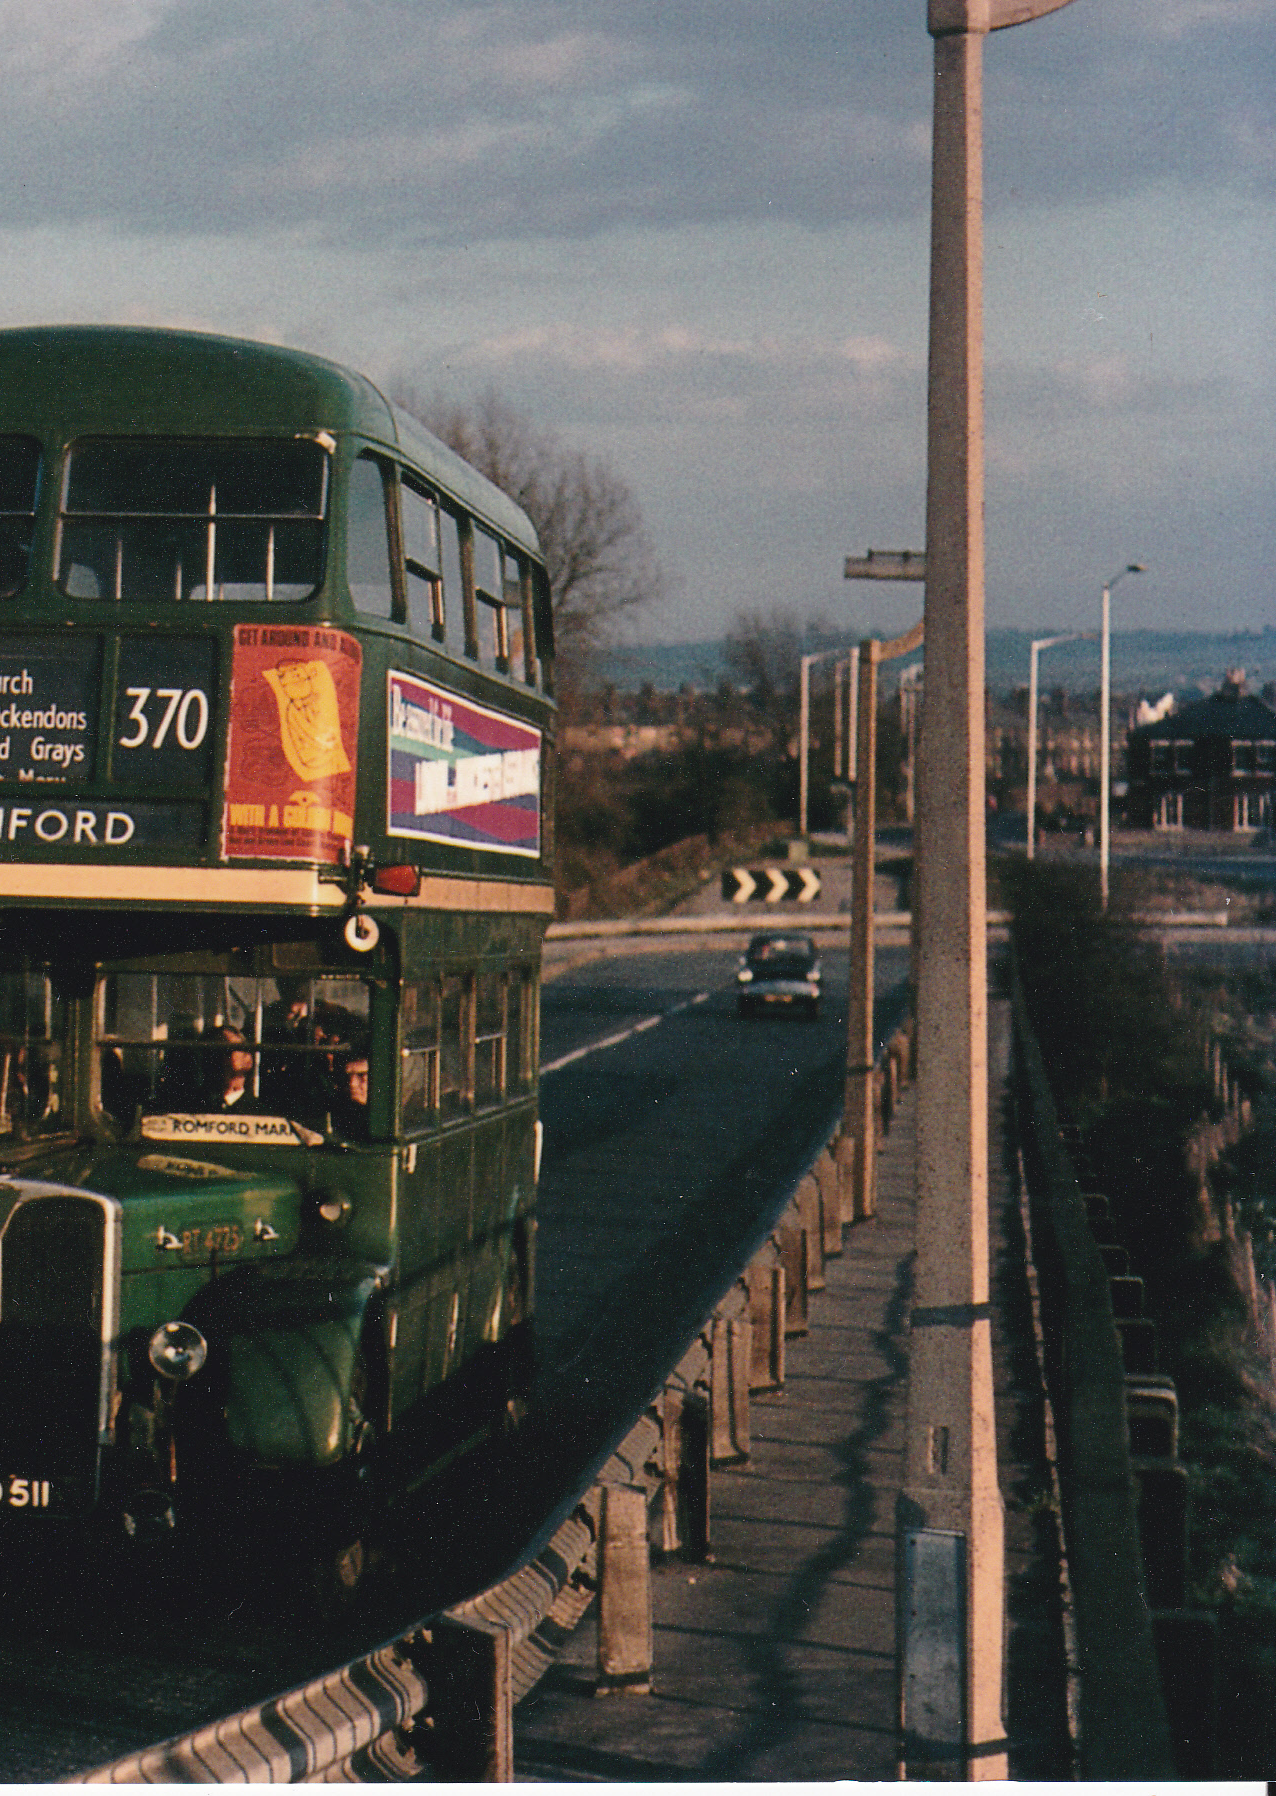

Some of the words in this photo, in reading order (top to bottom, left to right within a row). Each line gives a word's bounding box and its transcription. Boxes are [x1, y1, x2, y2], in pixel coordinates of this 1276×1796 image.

[119, 687, 210, 750] 370
[30, 736, 85, 769] Grays
[173, 1118, 249, 1135] ROMFORD
[9, 1478, 50, 1508] 511
